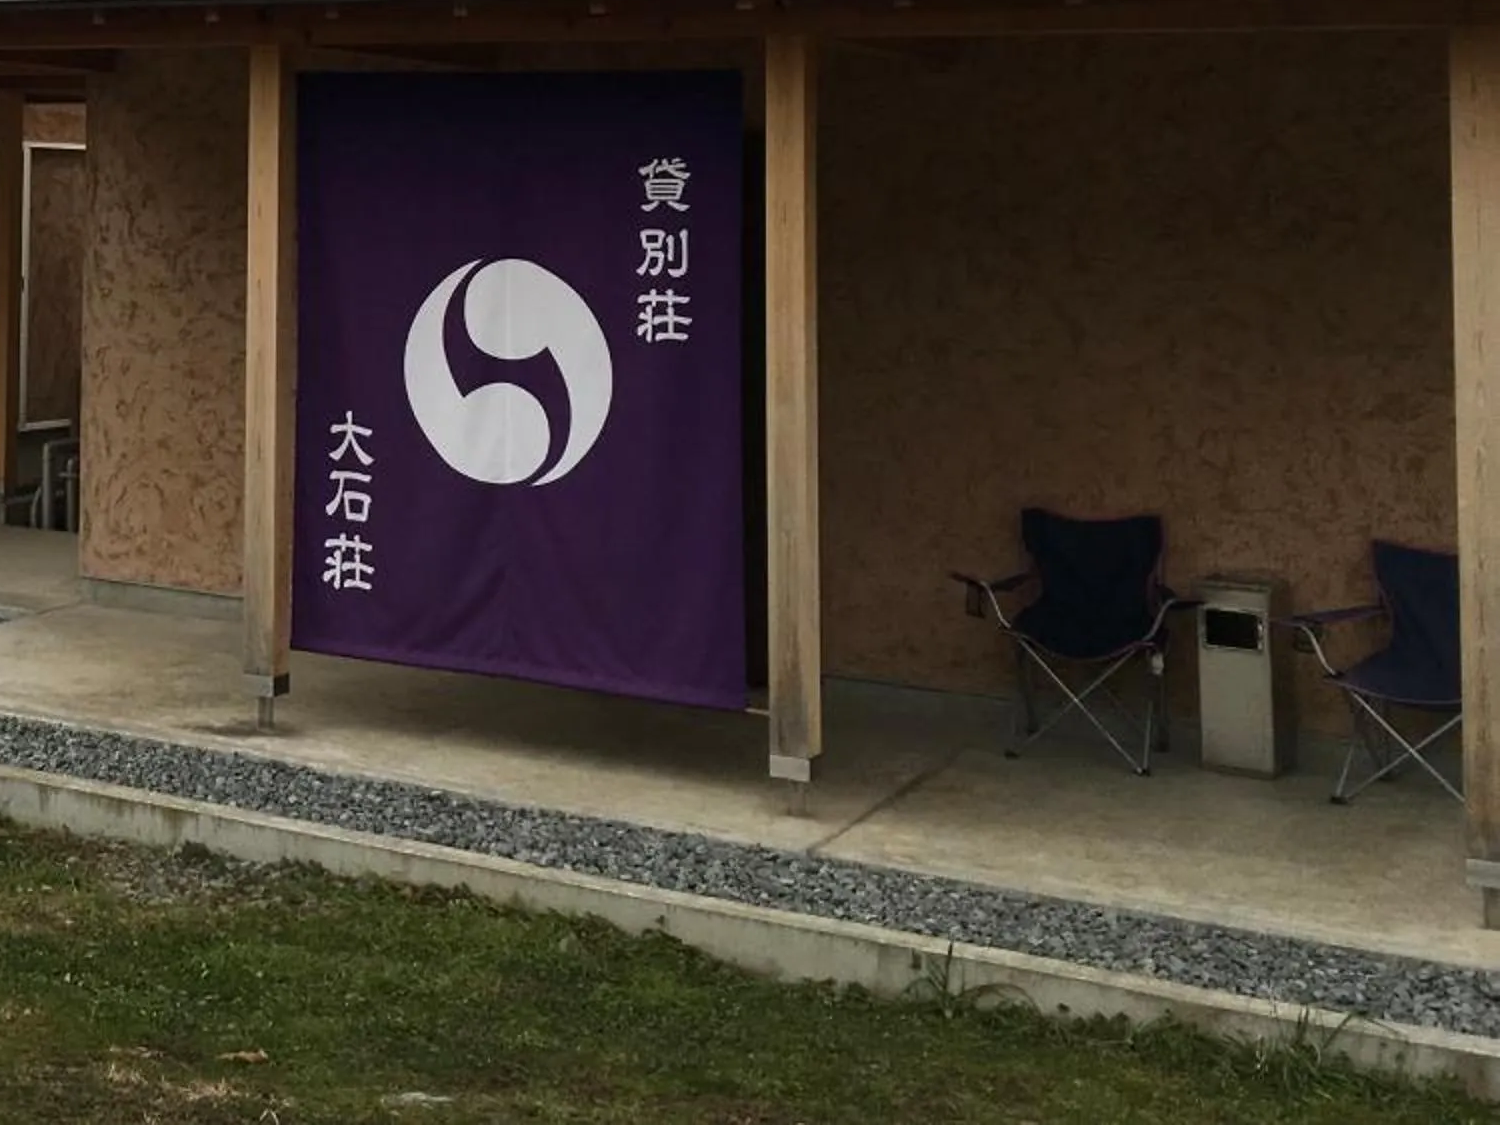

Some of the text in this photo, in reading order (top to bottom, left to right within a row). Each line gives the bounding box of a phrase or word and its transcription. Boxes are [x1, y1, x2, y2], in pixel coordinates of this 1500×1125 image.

[635, 157, 693, 343] 貸別荘
[322, 410, 375, 591] 大石荘
